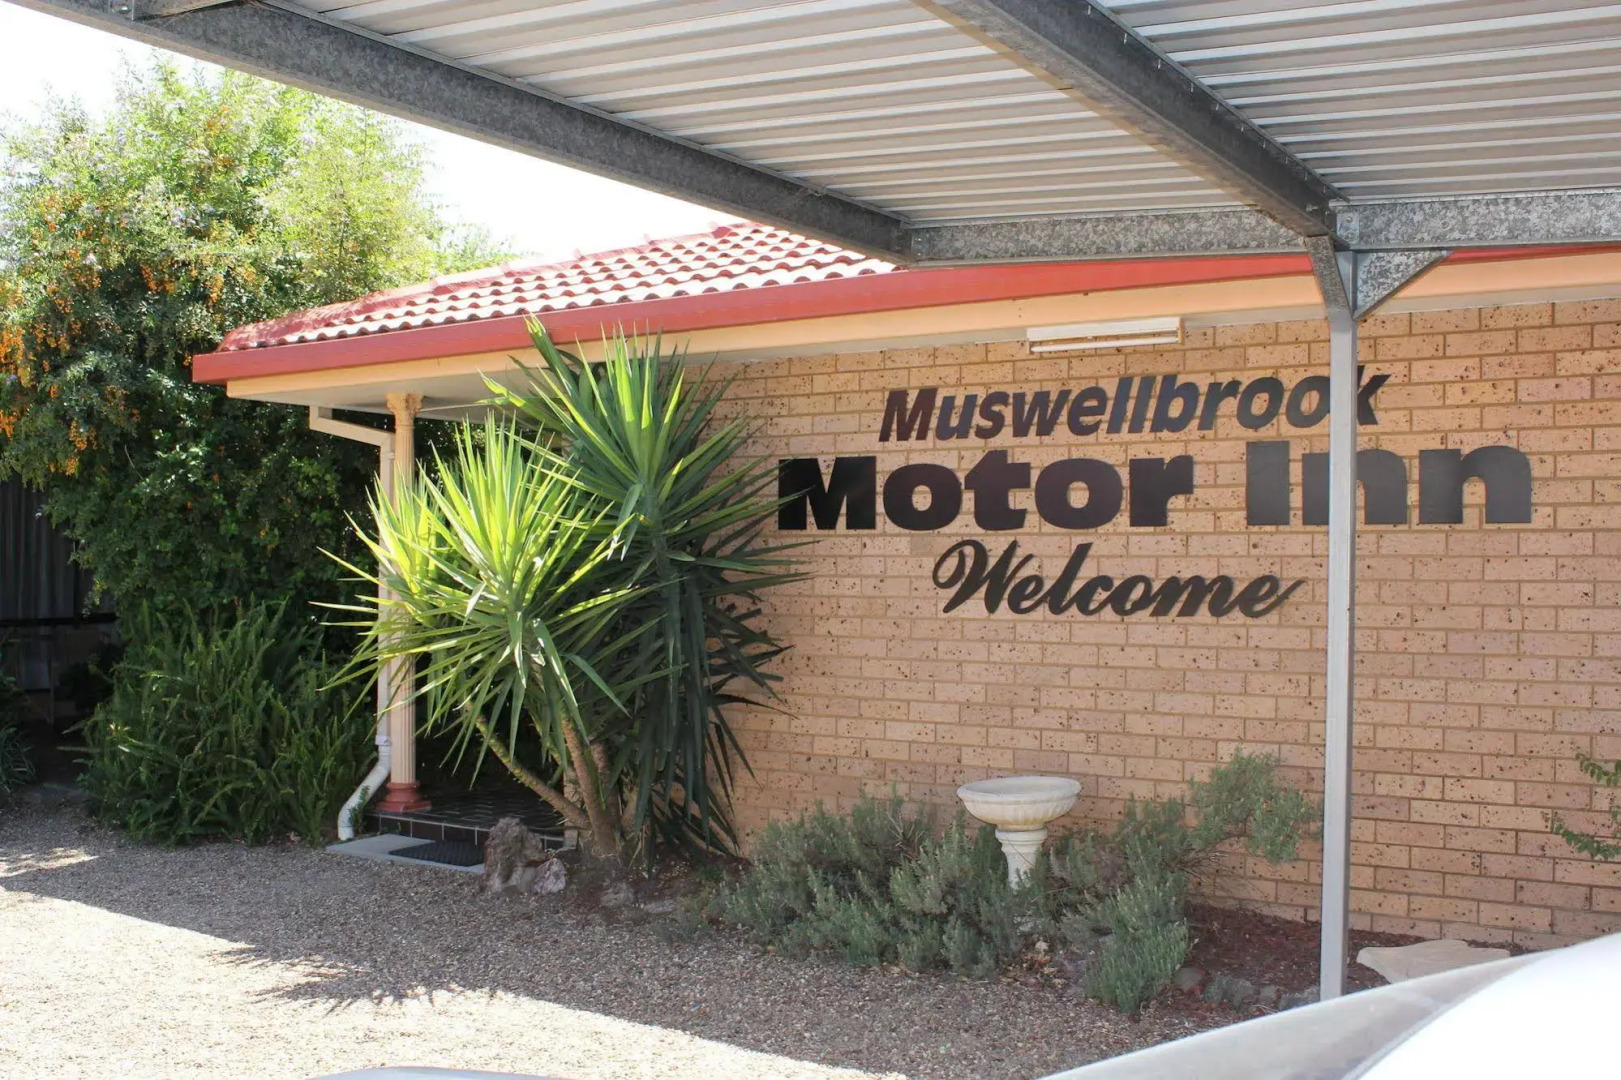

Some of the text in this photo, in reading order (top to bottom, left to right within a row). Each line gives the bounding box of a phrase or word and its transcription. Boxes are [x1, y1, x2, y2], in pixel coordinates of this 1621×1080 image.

[878, 364, 1392, 443] Muswellbrook
[778, 440, 1532, 532] Motor Inn
[932, 538, 1307, 618] Welcome
